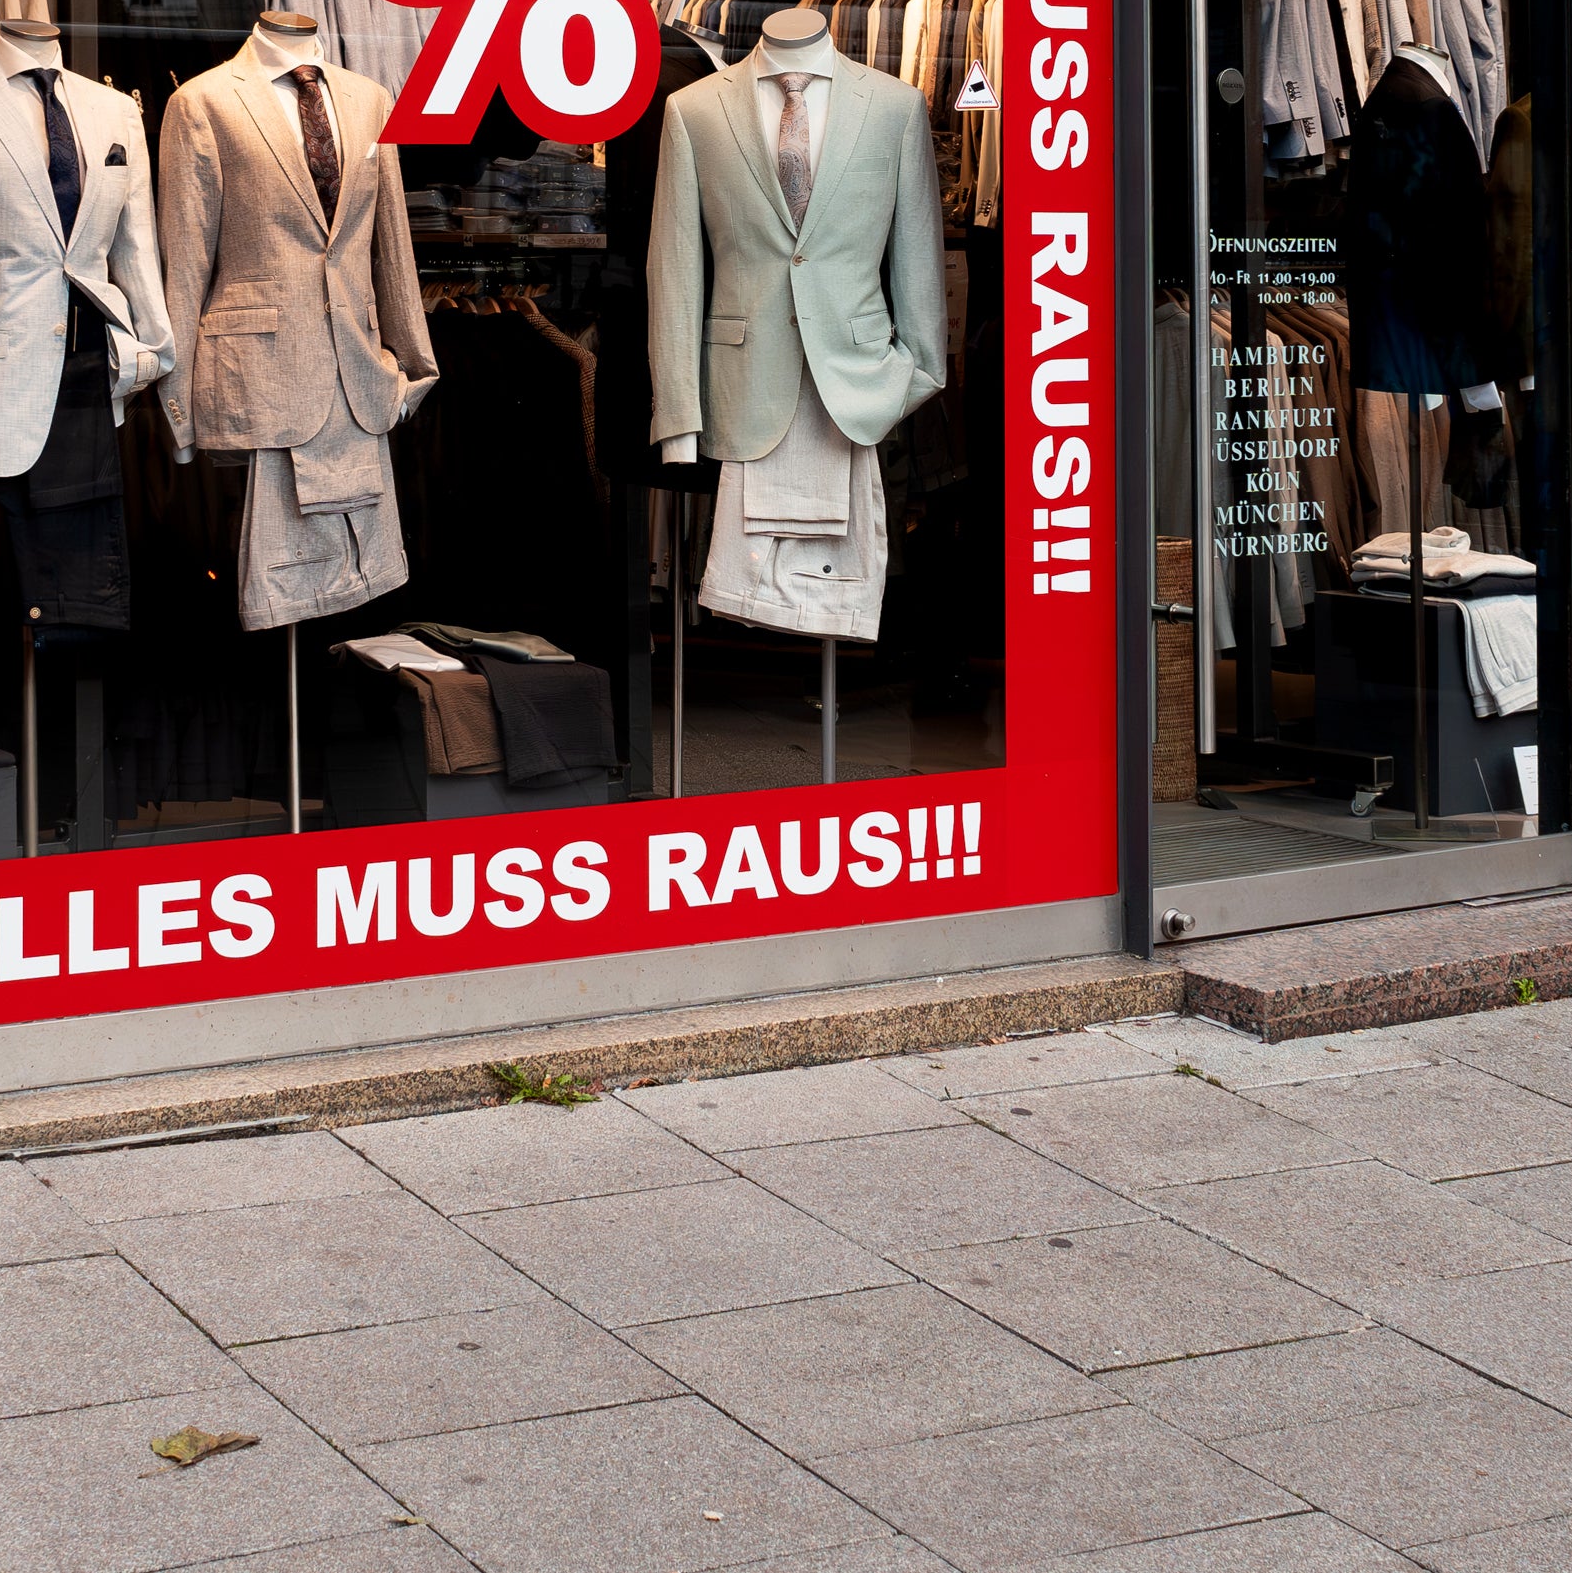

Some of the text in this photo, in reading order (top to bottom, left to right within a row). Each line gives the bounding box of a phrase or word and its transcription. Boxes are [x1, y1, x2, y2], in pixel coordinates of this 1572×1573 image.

[1211, 344, 1326, 367] HAMBURG
[1224, 376, 1314, 399] BERLIN
[1032, 212, 1091, 595] RAUS!!!
[1214, 407, 1336, 431] RANKFURT
[1212, 438, 1340, 462] ÜSSELDORF
[1245, 468, 1301, 493] KÖLN
[1215, 500, 1326, 526] MÜNCHEN
[1213, 531, 1329, 558] NÜRNBERG
[317, 841, 611, 948] MUSS
[649, 802, 981, 912] RAUS!!!
